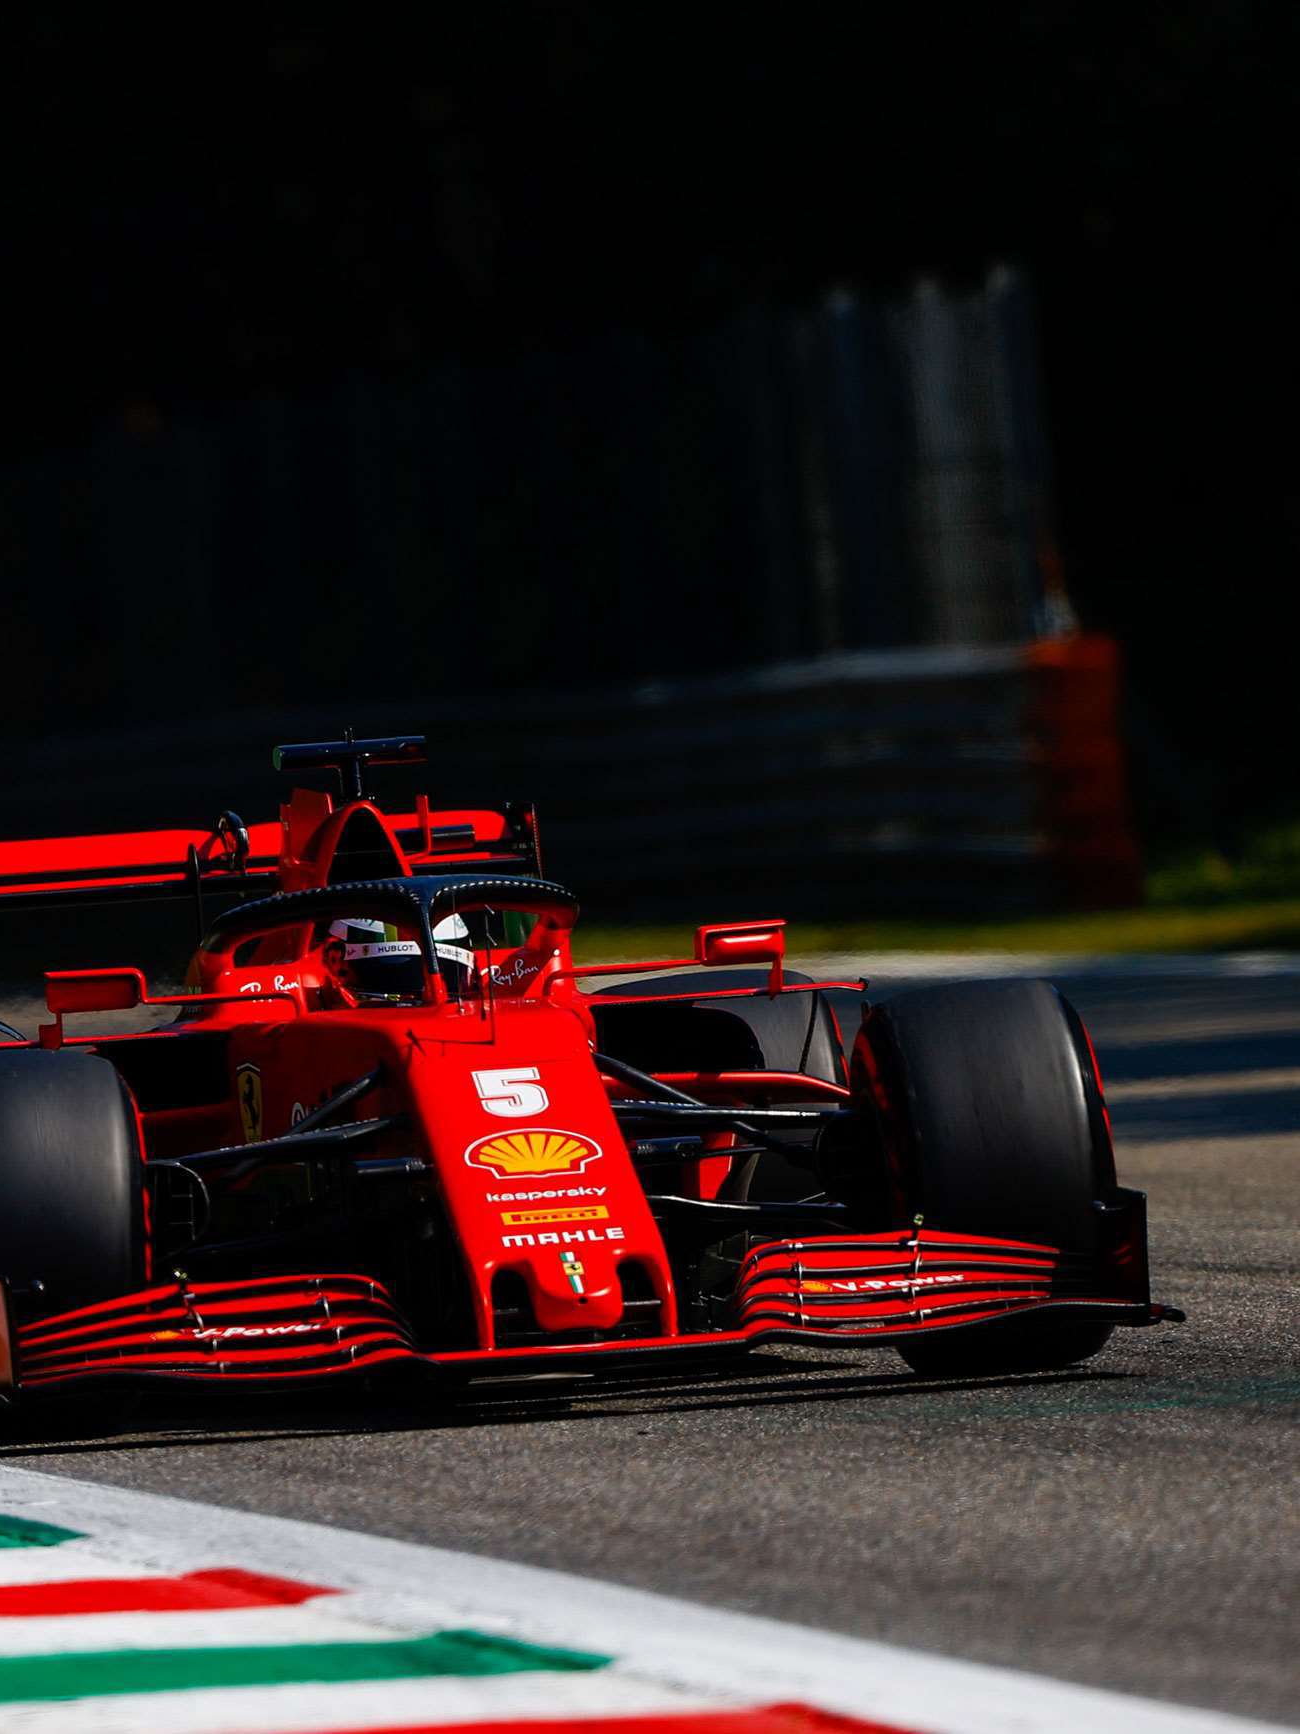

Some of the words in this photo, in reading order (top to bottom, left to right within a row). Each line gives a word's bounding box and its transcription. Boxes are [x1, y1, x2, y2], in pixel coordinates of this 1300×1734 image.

[377, 945, 414, 954] HUBLOT
[471, 1066, 549, 1118] 5
[486, 1186, 607, 1203] kaspersky
[501, 1227, 625, 1248] MAHLE
[832, 1274, 964, 1292] V-Power
